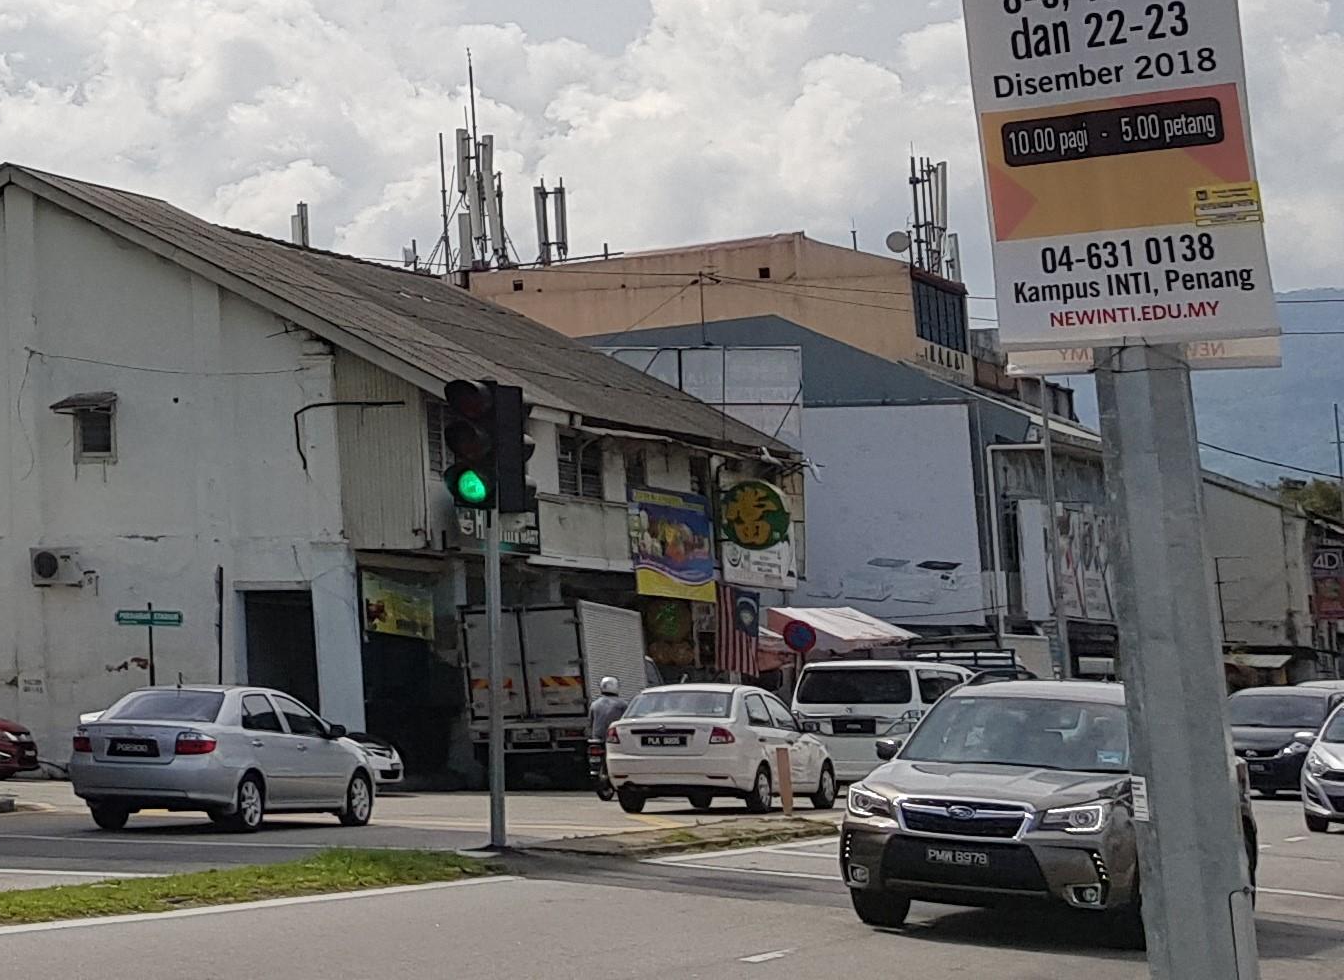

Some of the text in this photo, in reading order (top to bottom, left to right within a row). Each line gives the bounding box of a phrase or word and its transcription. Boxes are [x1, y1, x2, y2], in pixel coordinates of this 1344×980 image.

[1011, 0, 1189, 61] dan 22-23
[993, 47, 1217, 99] Disember 2018
[1008, 127, 1056, 157] 10.00
[1058, 123, 1089, 156] pagi
[1120, 114, 1160, 142] 5.00
[1163, 111, 1217, 148] petang
[1041, 232, 1216, 275] 04-631 0138
[1013, 266, 1255, 305] Kampus INTI, Penang
[1050, 300, 1220, 328] NEWINTI.EDU.MY
